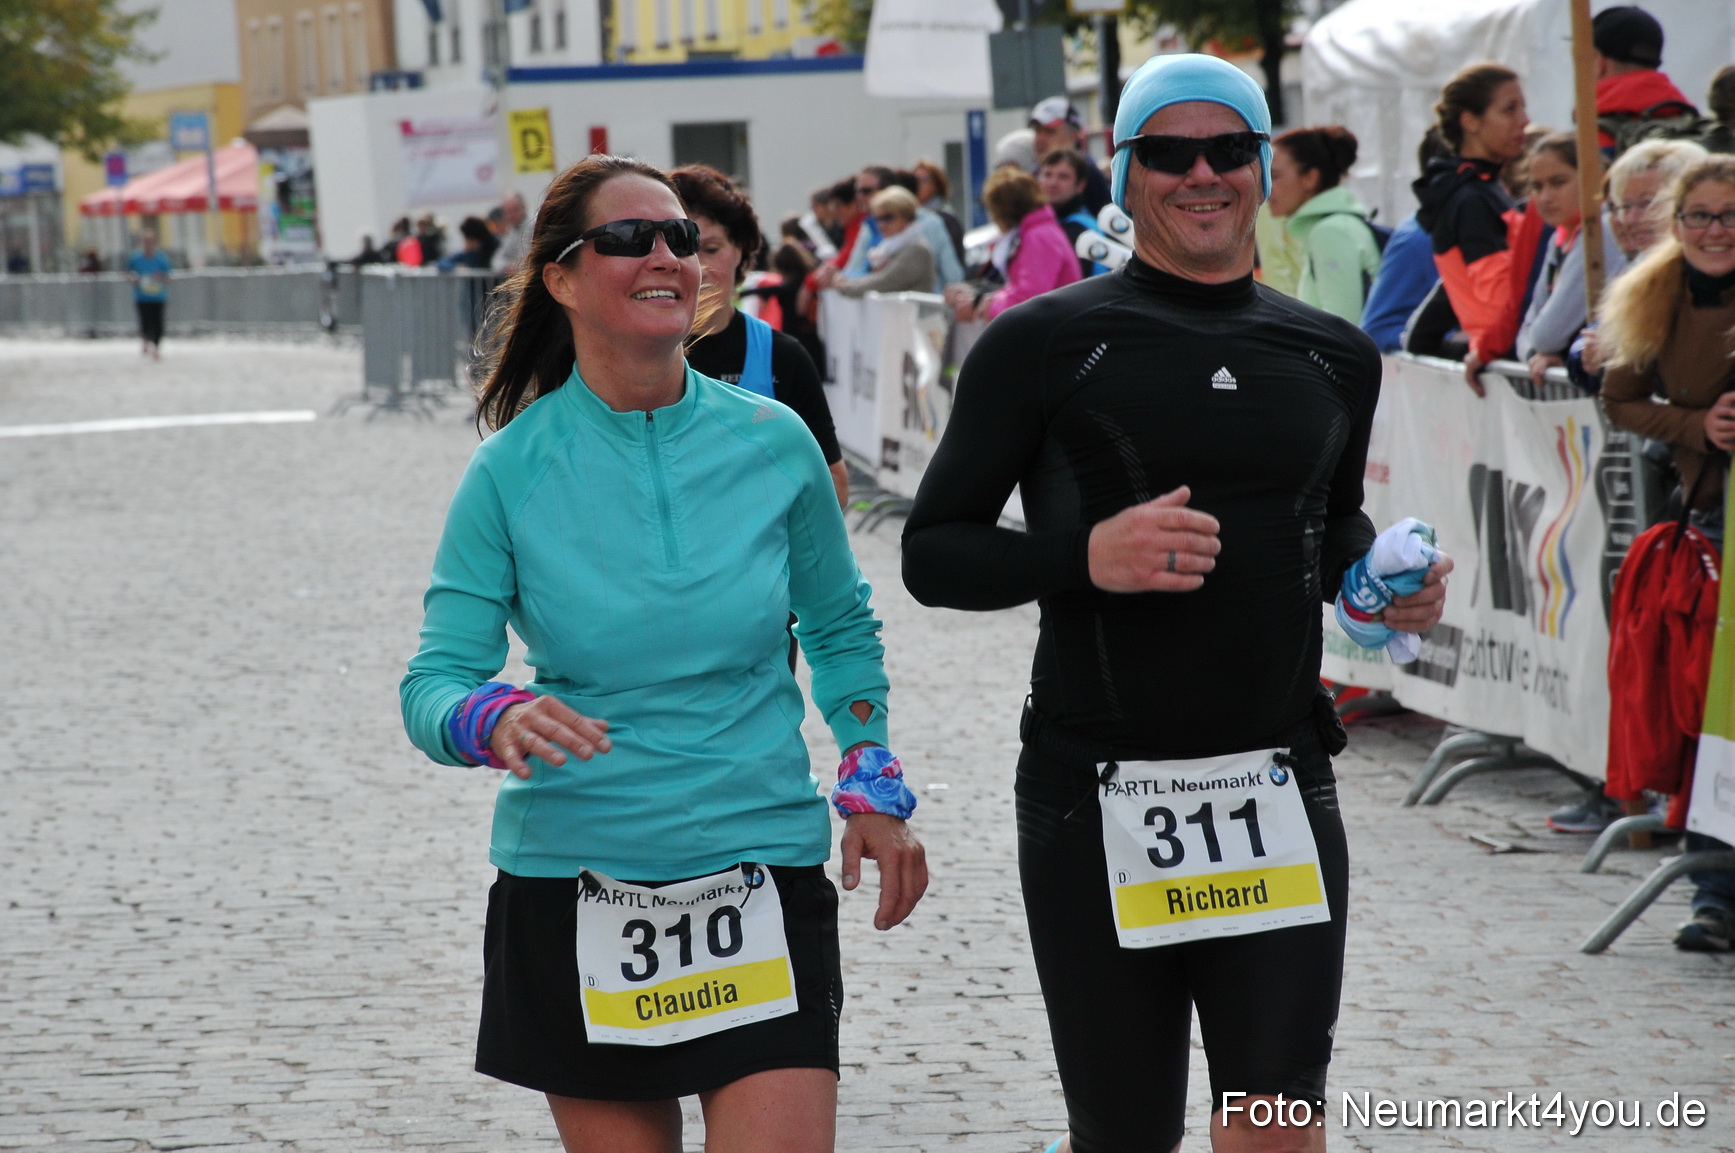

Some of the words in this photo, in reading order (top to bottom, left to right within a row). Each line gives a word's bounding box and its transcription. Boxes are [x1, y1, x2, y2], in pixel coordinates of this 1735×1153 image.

[520, 128, 545, 160] D
[1104, 779, 1166, 798] PARTL
[1171, 771, 1264, 794] Neumarkt
[1143, 797, 1267, 869] 311
[1117, 872, 1128, 884] D
[583, 887, 648, 909] PARTL
[1165, 878, 1269, 915] Richard
[620, 904, 744, 982] 310
[587, 976, 596, 987] D
[635, 980, 739, 1021] Claudia
